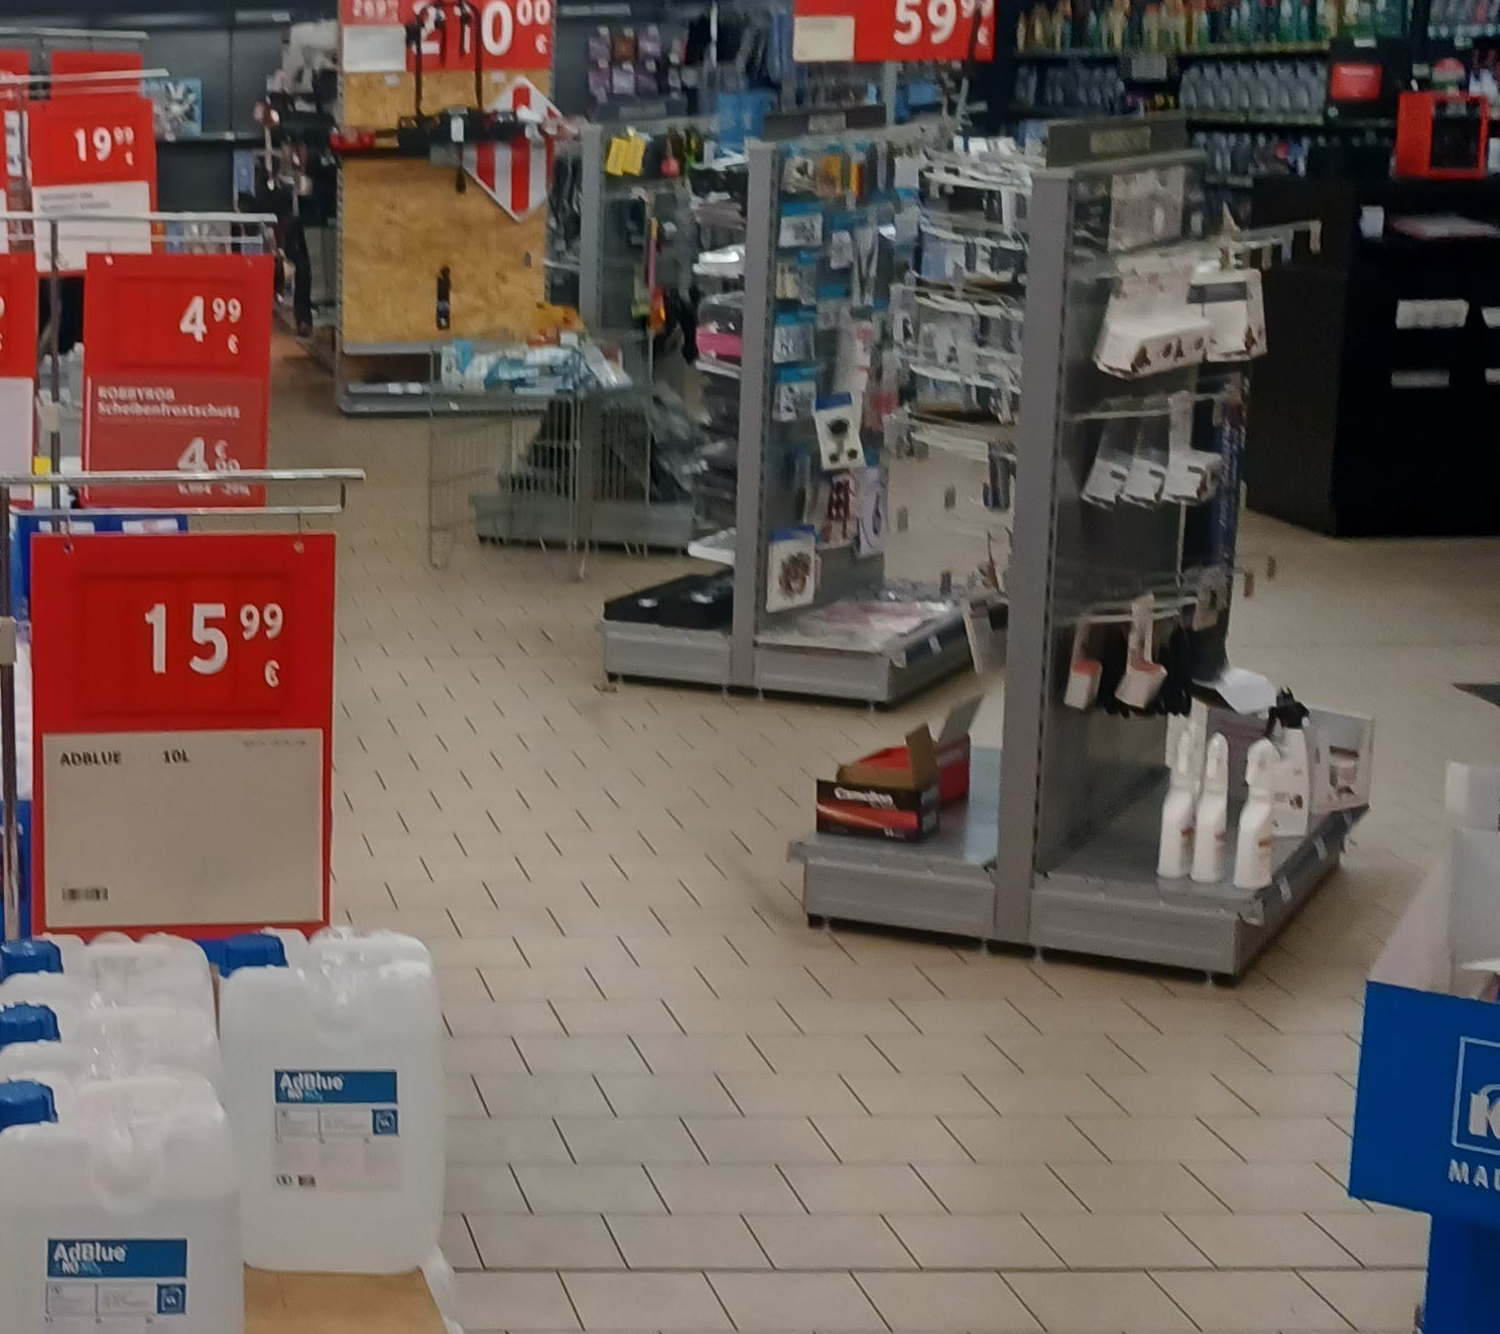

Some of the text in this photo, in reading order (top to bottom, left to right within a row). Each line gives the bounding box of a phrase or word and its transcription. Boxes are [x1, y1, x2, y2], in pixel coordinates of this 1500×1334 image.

[60, 749, 191, 767] ADBLUE 10L
[53, 1242, 127, 1263] AdBlue
